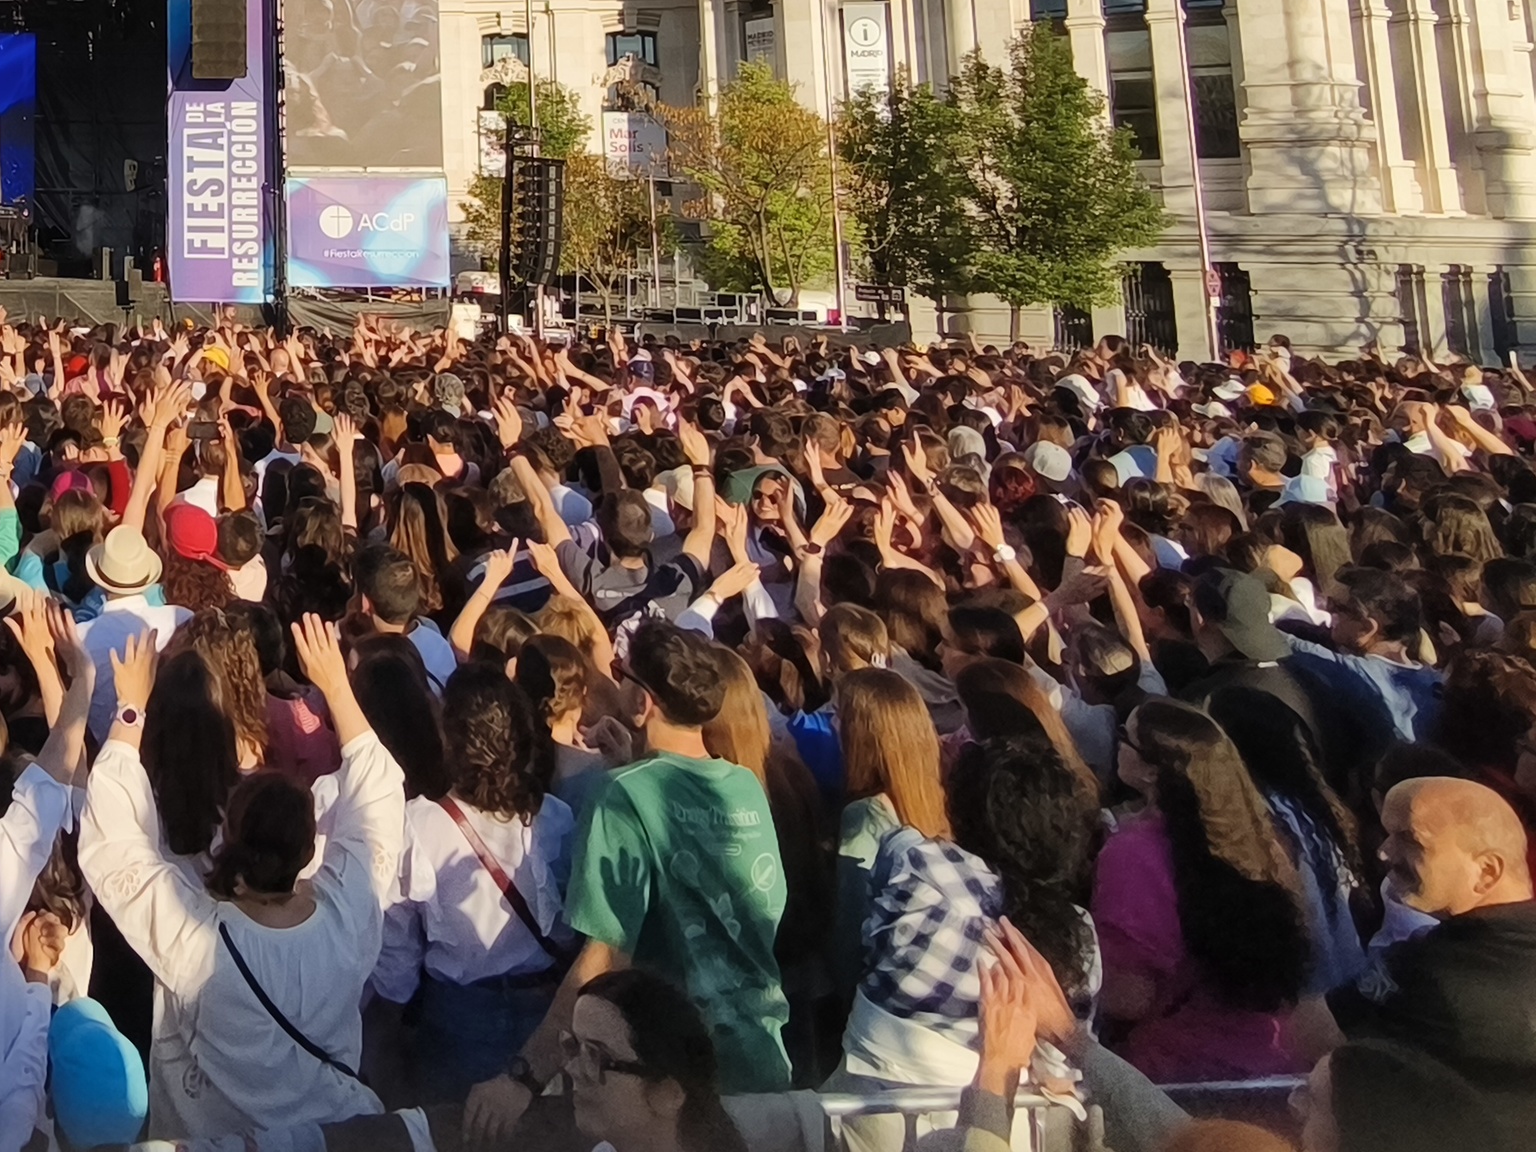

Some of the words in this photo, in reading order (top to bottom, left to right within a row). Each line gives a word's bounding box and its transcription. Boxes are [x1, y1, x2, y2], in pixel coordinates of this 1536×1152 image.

[185, 102, 204, 123] DE
[206, 102, 225, 123] LA
[610, 128, 638, 139] Mar
[186, 131, 225, 255] FIESTA
[225, 101, 259, 287] RESURRECCIÓN
[357, 212, 415, 232] ACdP
